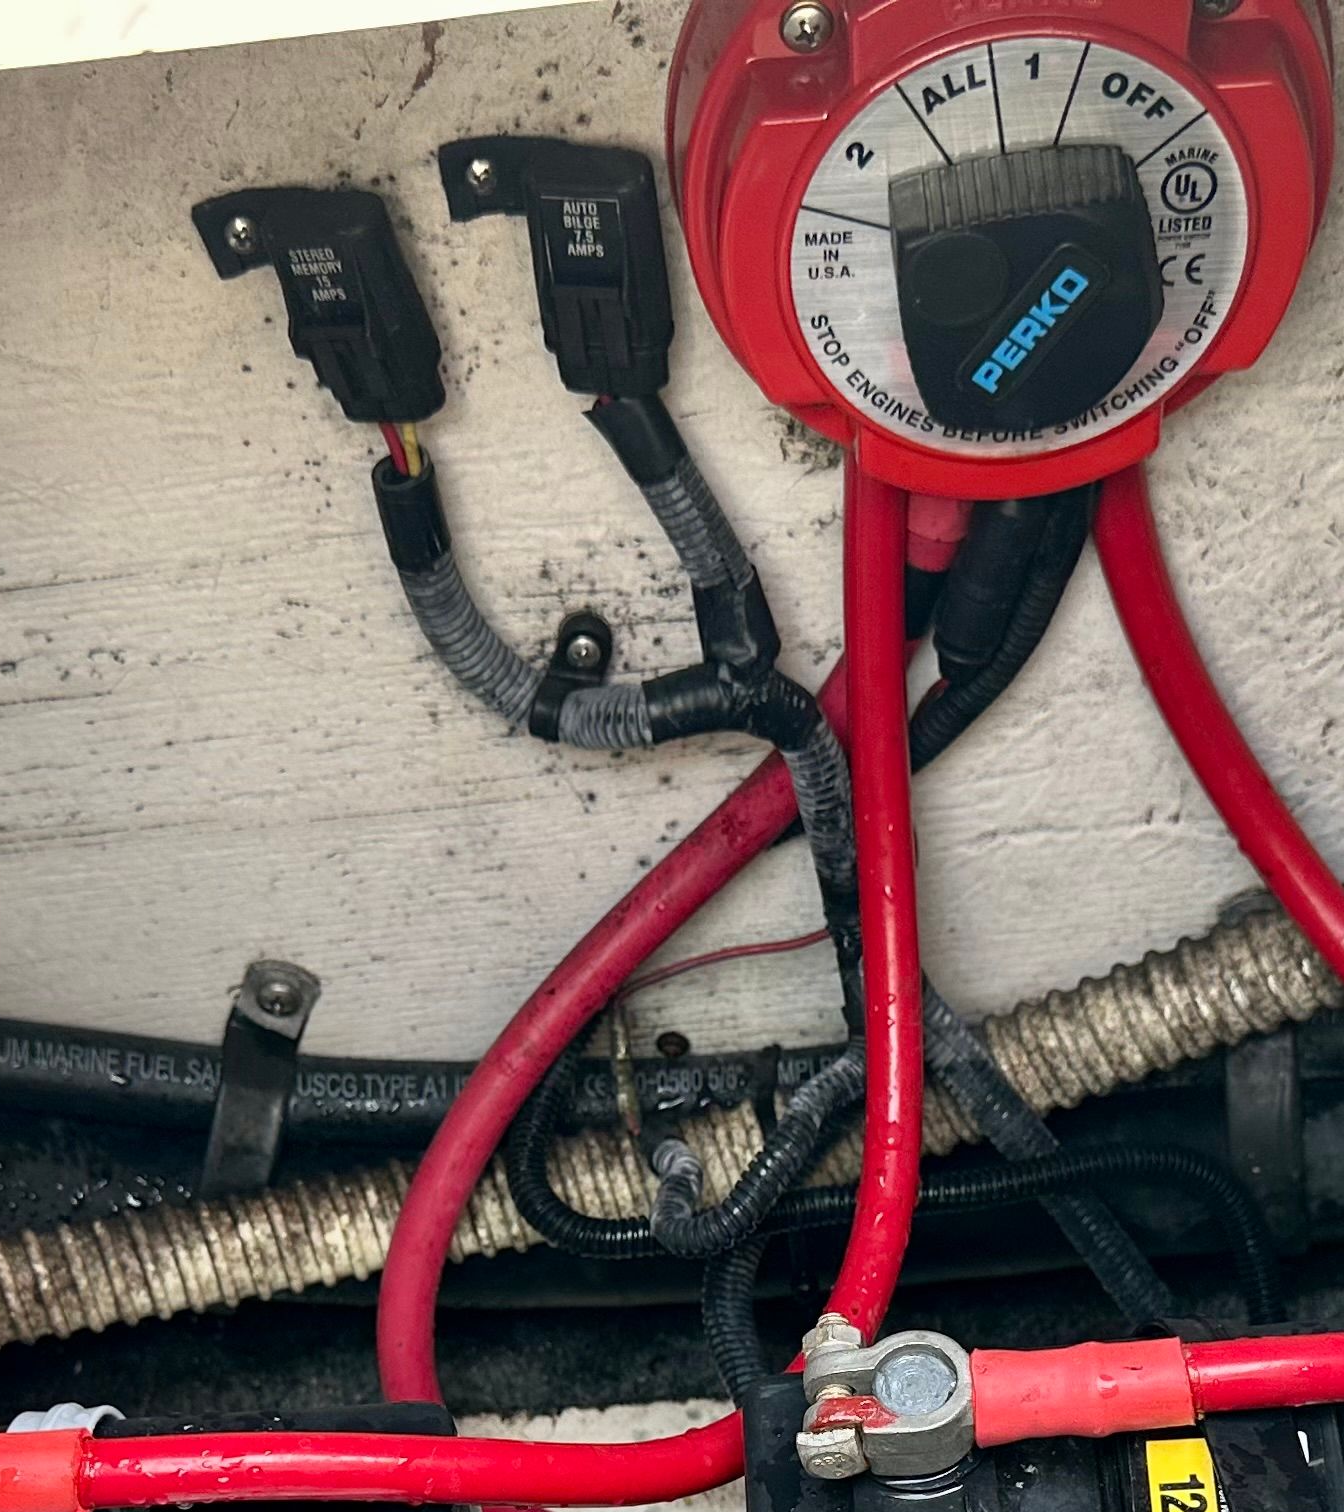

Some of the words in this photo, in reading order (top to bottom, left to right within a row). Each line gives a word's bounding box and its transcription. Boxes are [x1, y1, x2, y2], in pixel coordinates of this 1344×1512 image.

[1025, 52, 1040, 80] 1
[921, 64, 987, 116] ALL
[1102, 72, 1174, 119] OFF
[845, 141, 874, 170] 2
[1164, 147, 1219, 167] MARINE
[563, 202, 597, 216] AUTO
[563, 215, 600, 230] BILGE
[1159, 216, 1212, 233] LISTED
[804, 231, 853, 247] MADE
[288, 247, 334, 262] STEREO
[567, 244, 604, 258] AMPS
[823, 249, 839, 262] IN
[290, 260, 343, 276] MEMORY
[808, 265, 855, 280] U.S.A.
[312, 288, 346, 301] AMPS
[971, 266, 1088, 395] PERKO
[811, 314, 850, 367] STOP
[845, 368, 934, 433] ENGINES
[1054, 356, 1179, 435] SWITCHING
[34, 1040, 120, 1076] MARINE
[125, 1050, 180, 1082] FUEL
[297, 1074, 360, 1099] USCG
[363, 1074, 418, 1099] TYPE
